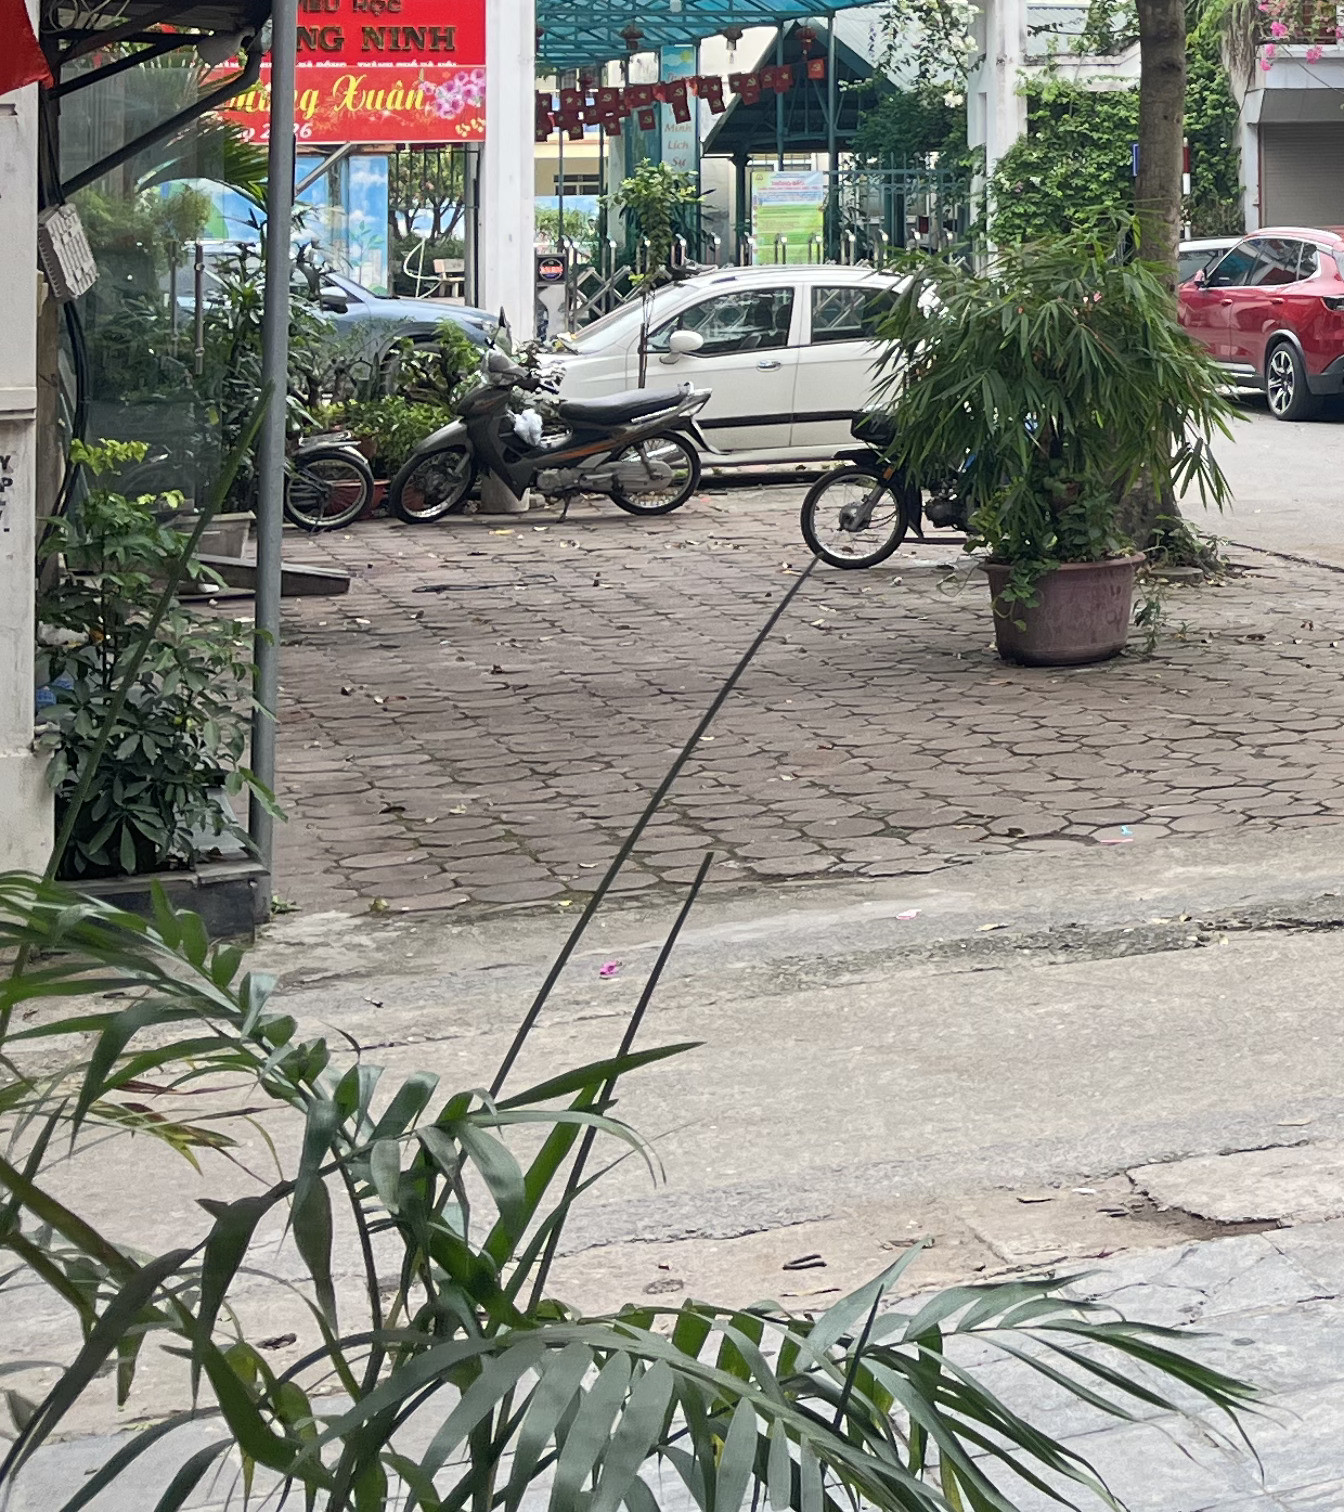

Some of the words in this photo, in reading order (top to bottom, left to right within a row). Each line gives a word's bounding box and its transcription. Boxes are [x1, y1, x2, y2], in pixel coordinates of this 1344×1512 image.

[297, 25, 345, 52] NG
[361, 25, 457, 52] NINH
[332, 74, 425, 112] Xuân
